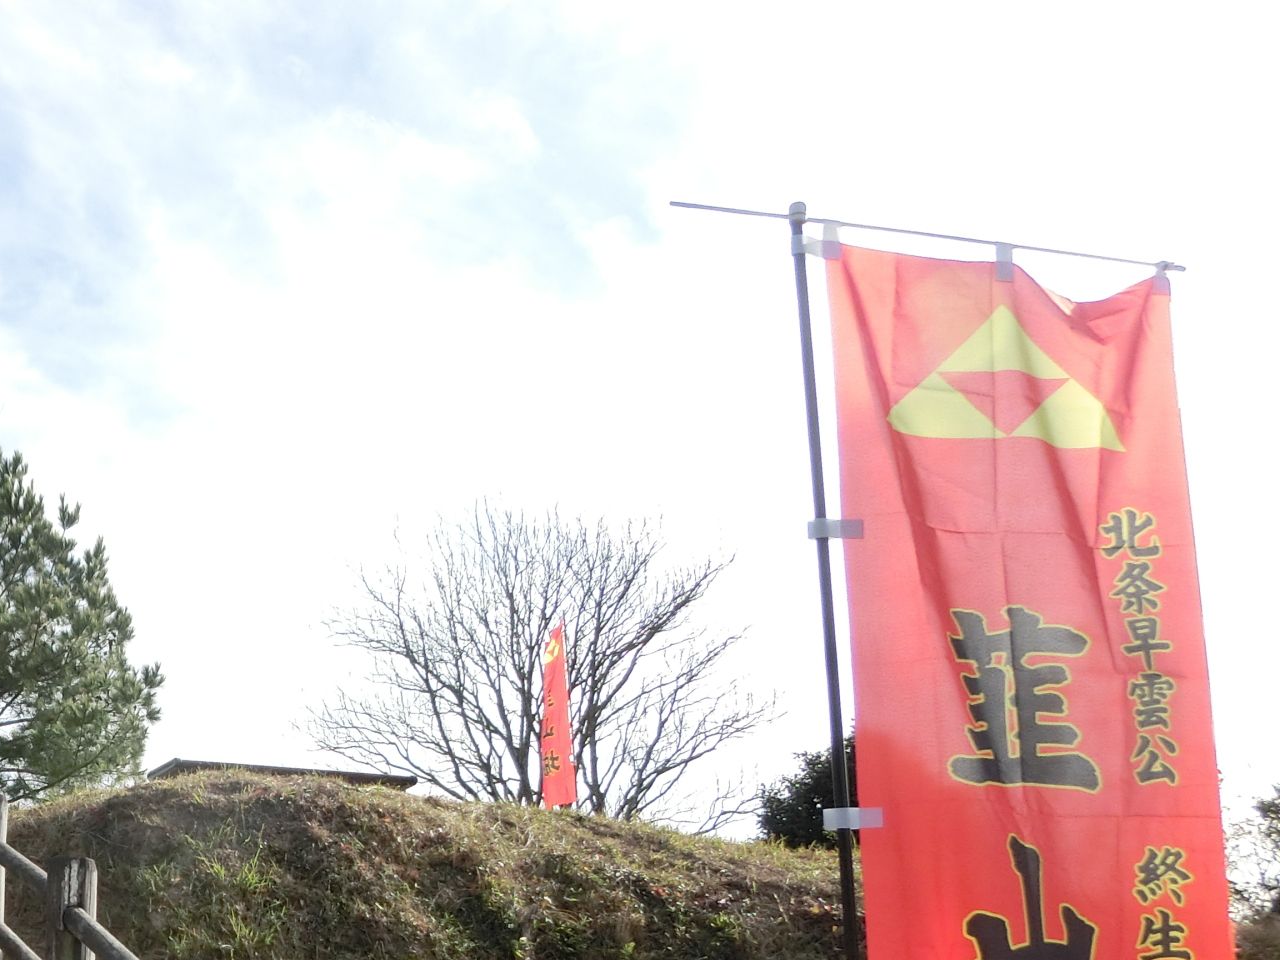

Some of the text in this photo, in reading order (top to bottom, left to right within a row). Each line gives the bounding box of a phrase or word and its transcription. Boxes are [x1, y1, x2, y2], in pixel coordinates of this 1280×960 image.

[1099, 507, 1180, 787] 北条早雲公
